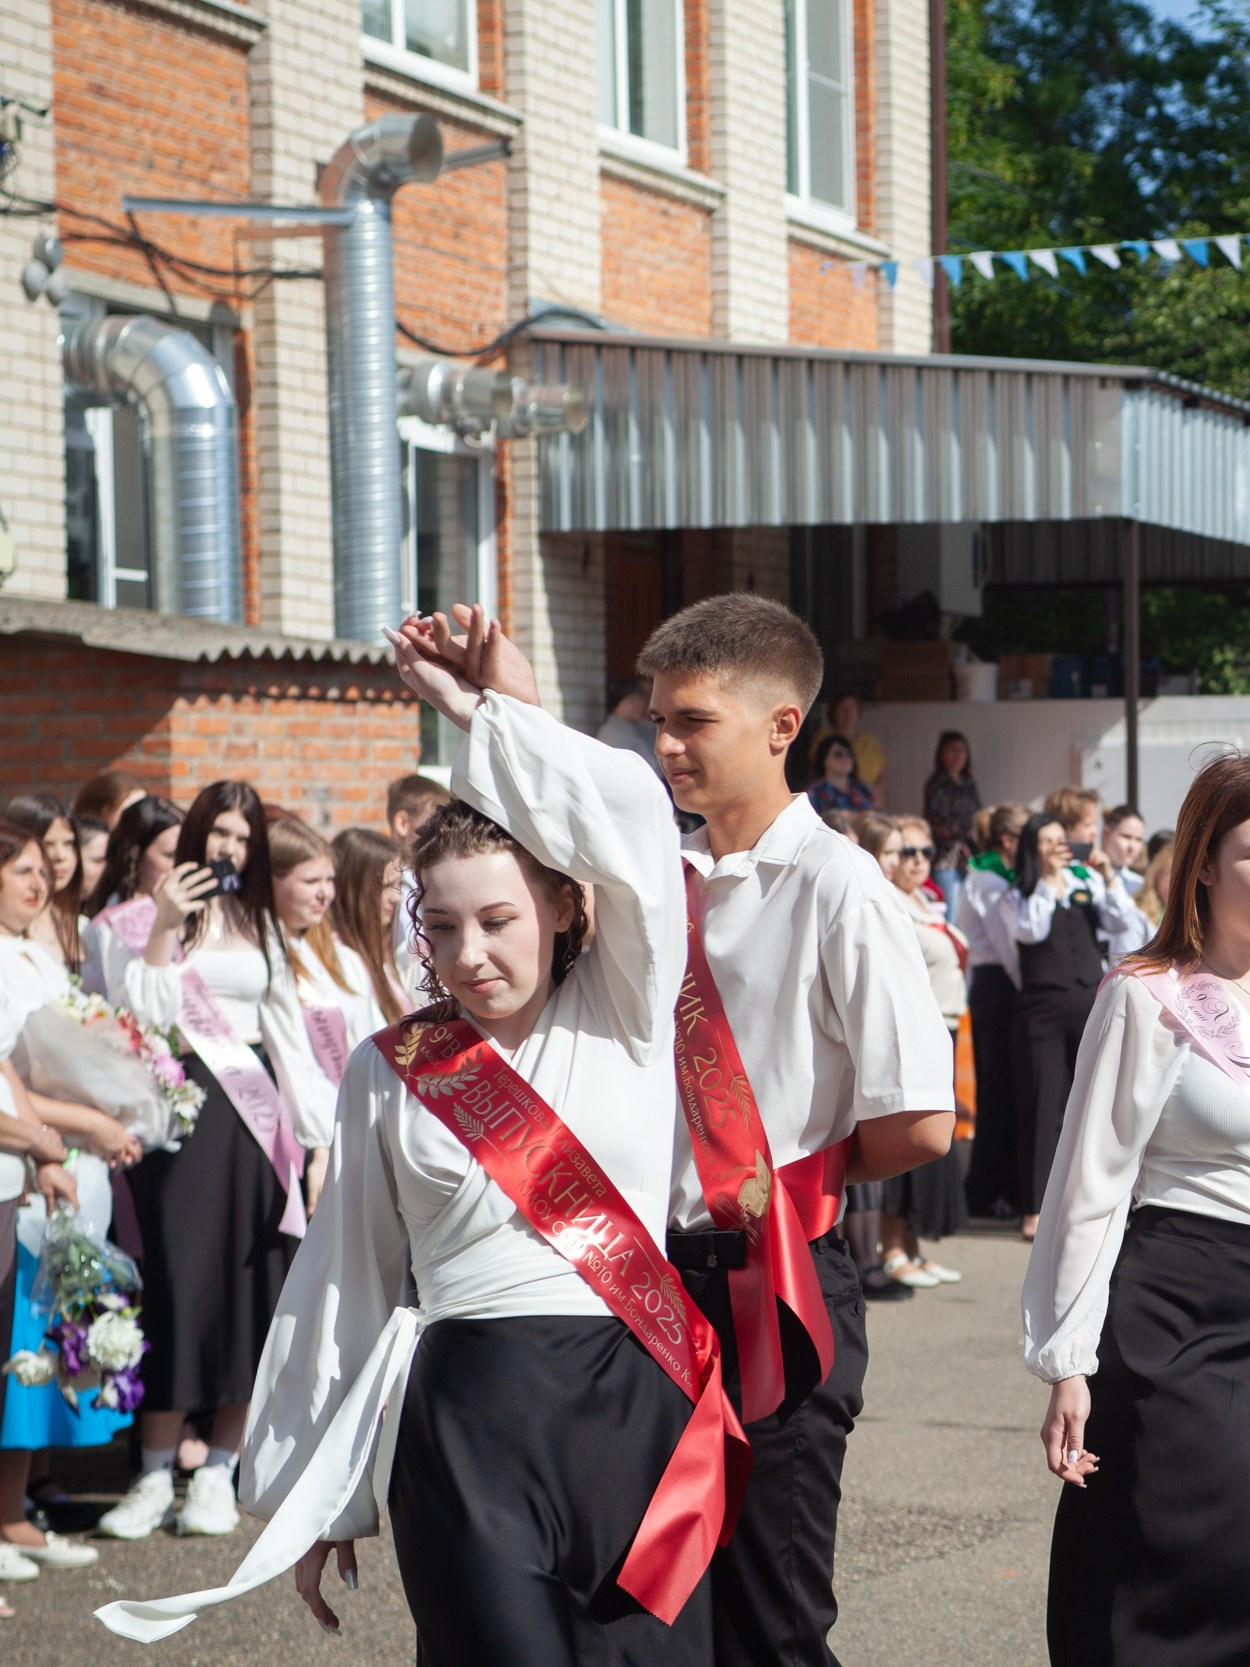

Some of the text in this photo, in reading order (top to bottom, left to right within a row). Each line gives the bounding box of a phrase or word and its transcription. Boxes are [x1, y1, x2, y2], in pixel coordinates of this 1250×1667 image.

[493, 1065, 552, 1131] Терешкова
[693, 1046, 736, 1128] 2025
[460, 1079, 685, 1345] ВЫПУСКНИЦА 2025
[517, 1179, 556, 1221] МАОУ
[582, 1250, 613, 1284] №10
[609, 1283, 681, 1372] им.Бондаренко
